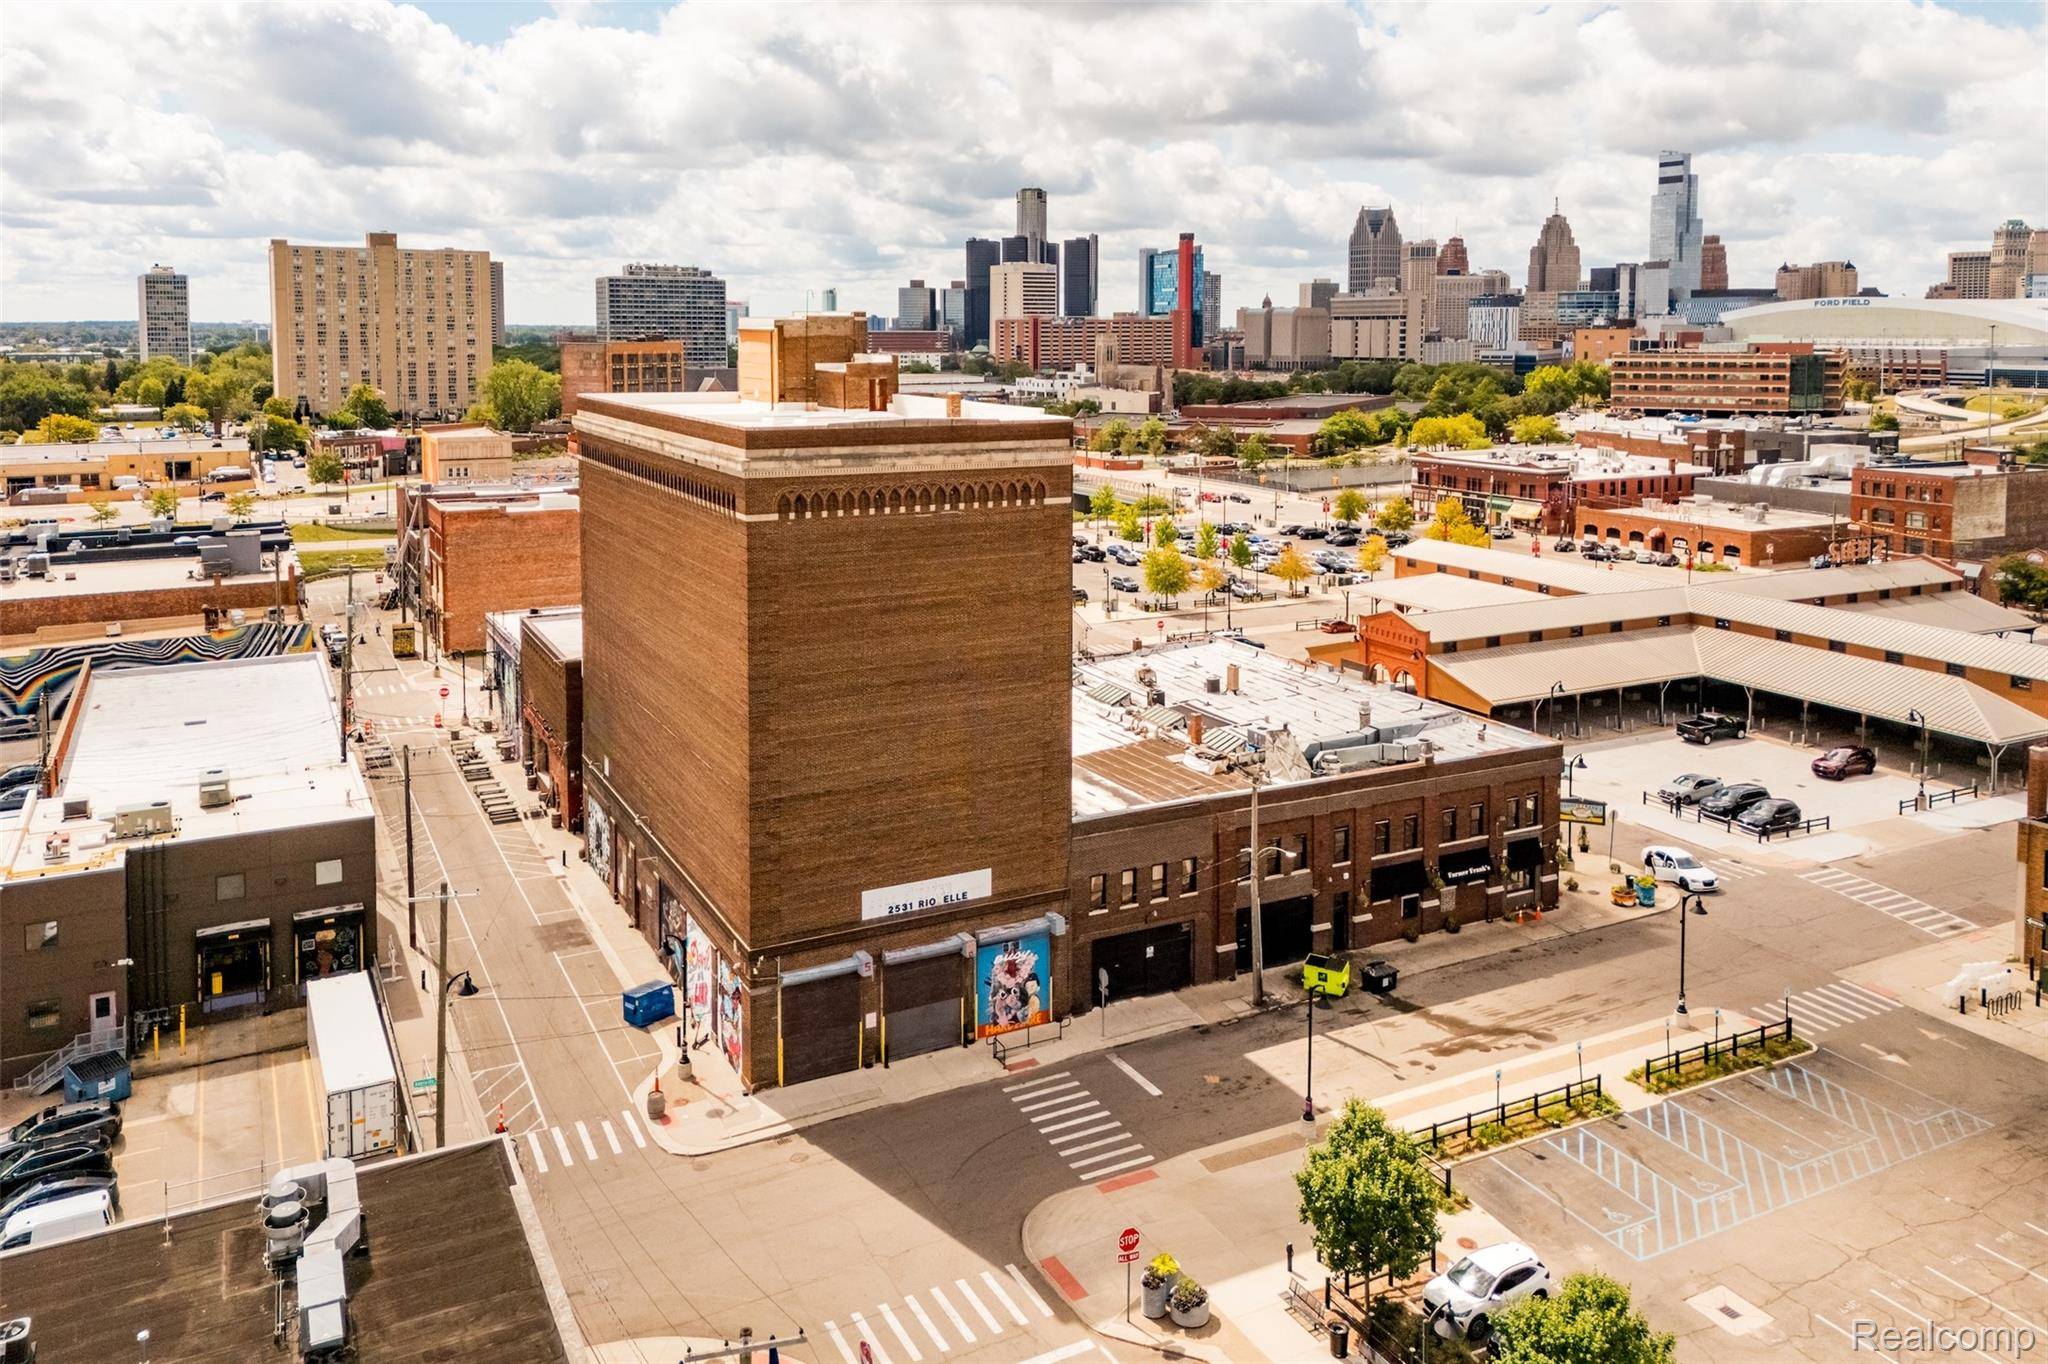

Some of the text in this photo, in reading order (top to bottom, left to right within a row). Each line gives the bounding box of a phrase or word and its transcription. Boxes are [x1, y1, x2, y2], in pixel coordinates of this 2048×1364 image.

[1814, 298, 1871, 307] FORD FIELD
[888, 891, 968, 914] 2531 RIO ELLE
[1119, 1233, 1139, 1247] STOP
